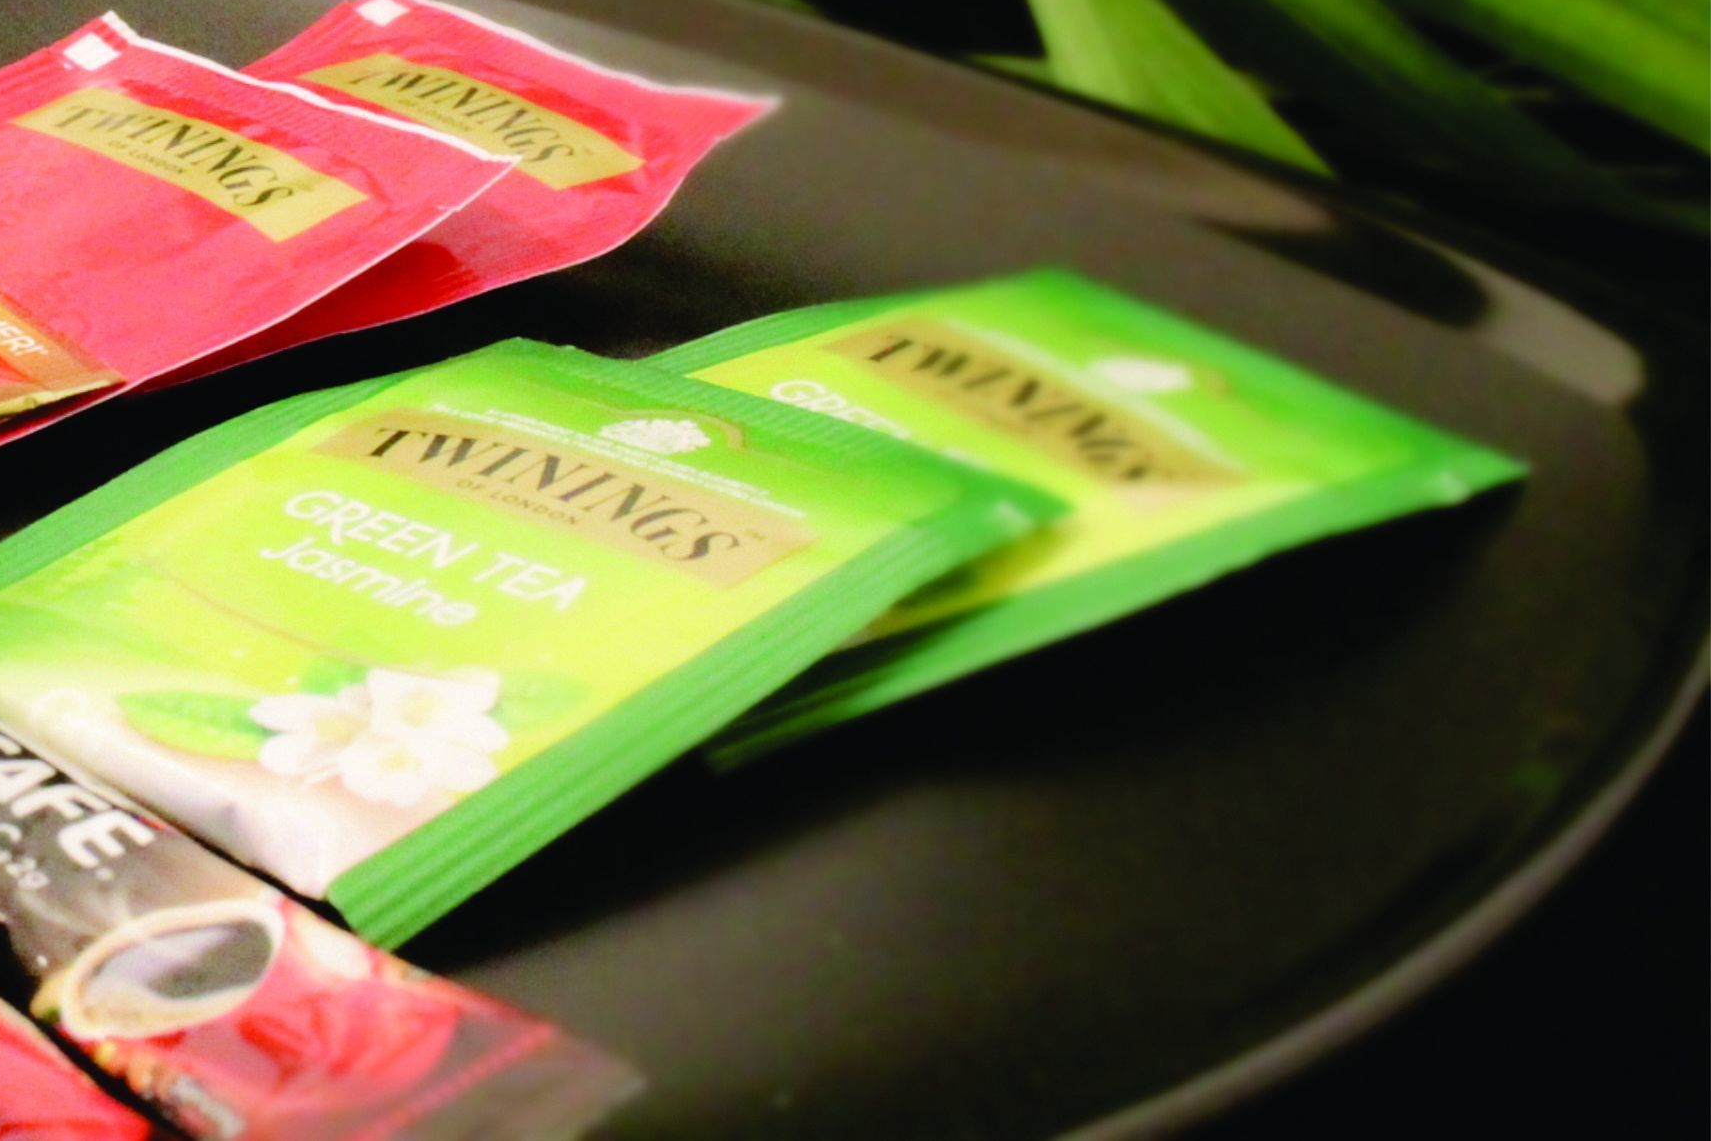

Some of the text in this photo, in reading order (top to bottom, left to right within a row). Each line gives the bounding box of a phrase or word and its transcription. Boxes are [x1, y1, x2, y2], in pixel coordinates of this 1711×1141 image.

[54, 105, 294, 207] TWININGS
[349, 71, 575, 162] TWININGS
[368, 427, 743, 561] TWININGS
[456, 476, 580, 527] OF LONDON
[259, 536, 478, 627] Jasmine
[284, 490, 593, 612] GREEN TEA
